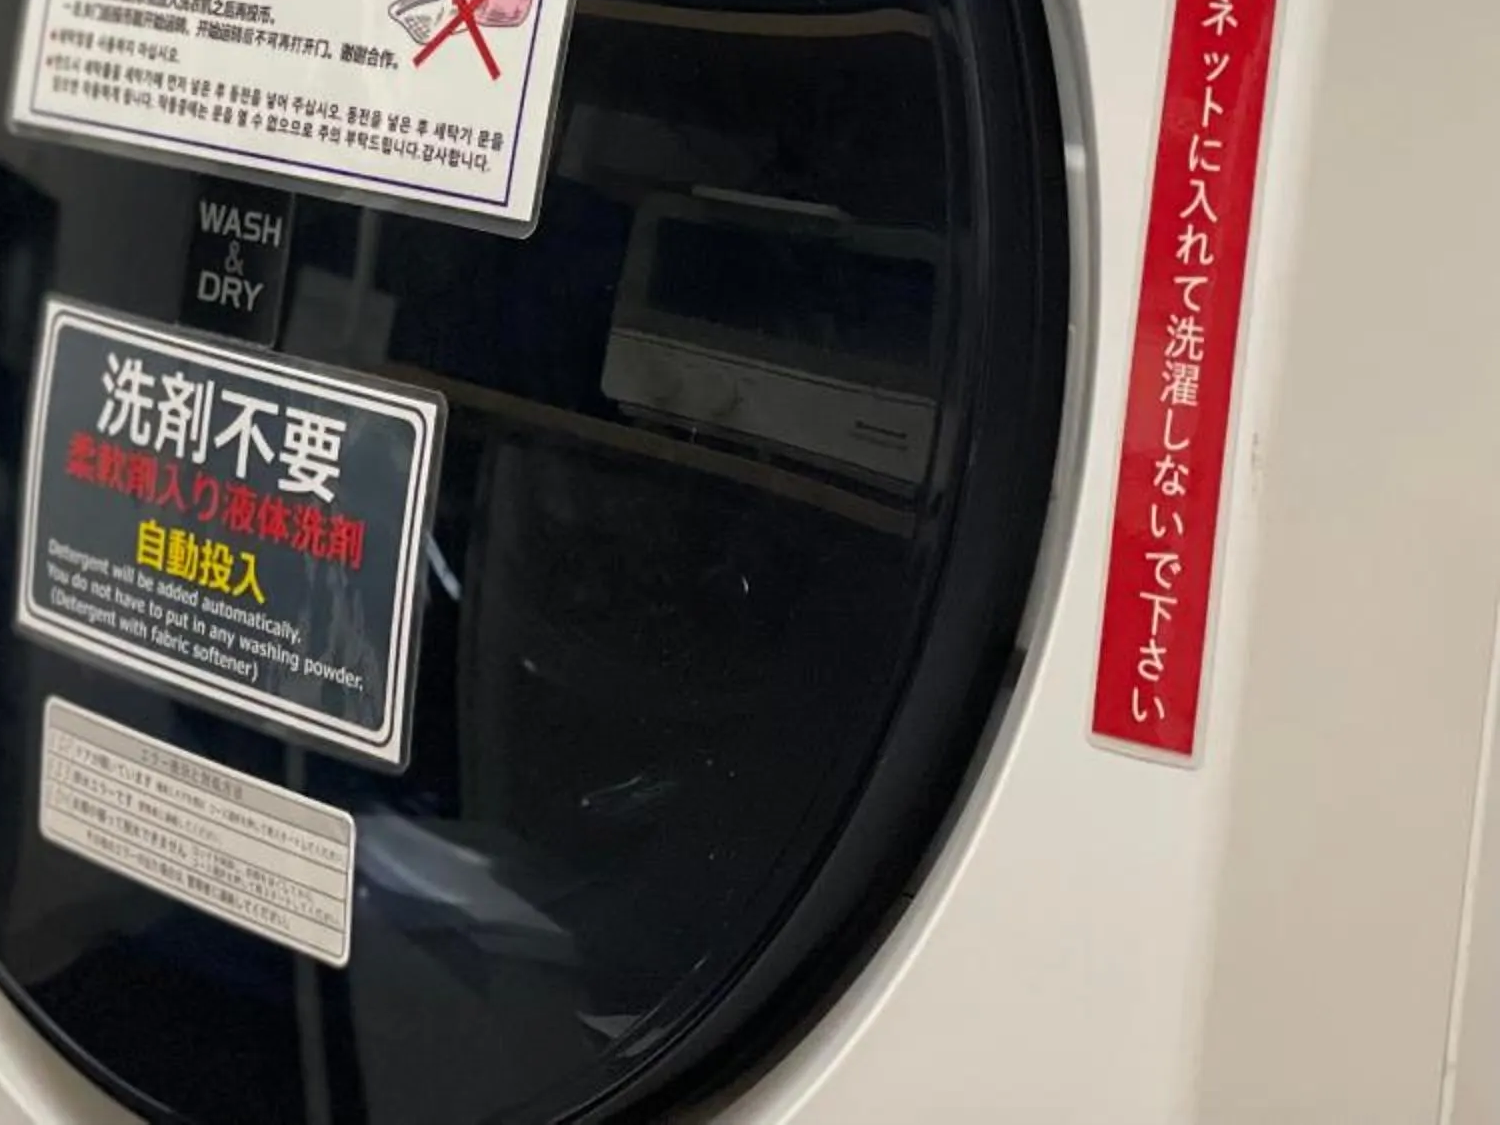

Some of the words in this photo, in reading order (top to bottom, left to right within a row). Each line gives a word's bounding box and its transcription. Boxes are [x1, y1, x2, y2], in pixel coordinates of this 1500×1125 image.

[200, 197, 282, 248] WASH
[225, 239, 244, 276] &
[197, 270, 264, 312] DRY
[97, 351, 347, 504] 洗剤不要
[65, 431, 368, 570] 柔軟剤入り液体洗剤
[47, 539, 110, 575] Detergent
[112, 563, 136, 584] will
[137, 570, 154, 591] be
[157, 576, 200, 607] added
[202, 596, 303, 644] automatically.
[134, 518, 267, 605] 自動投入
[46, 561, 70, 586] You
[71, 570, 88, 591] do
[91, 578, 112, 600] not
[115, 585, 146, 614] have
[149, 599, 164, 619] to
[165, 605, 191, 631] put
[193, 614, 207, 634] in
[209, 624, 236, 649] any
[239, 632, 302, 673] washing
[303, 657, 365, 692] powder.
[50, 589, 117, 626] (Detergent
[119, 610, 149, 639] with
[150, 623, 191, 656] fabric
[192, 643, 260, 683] softener)
